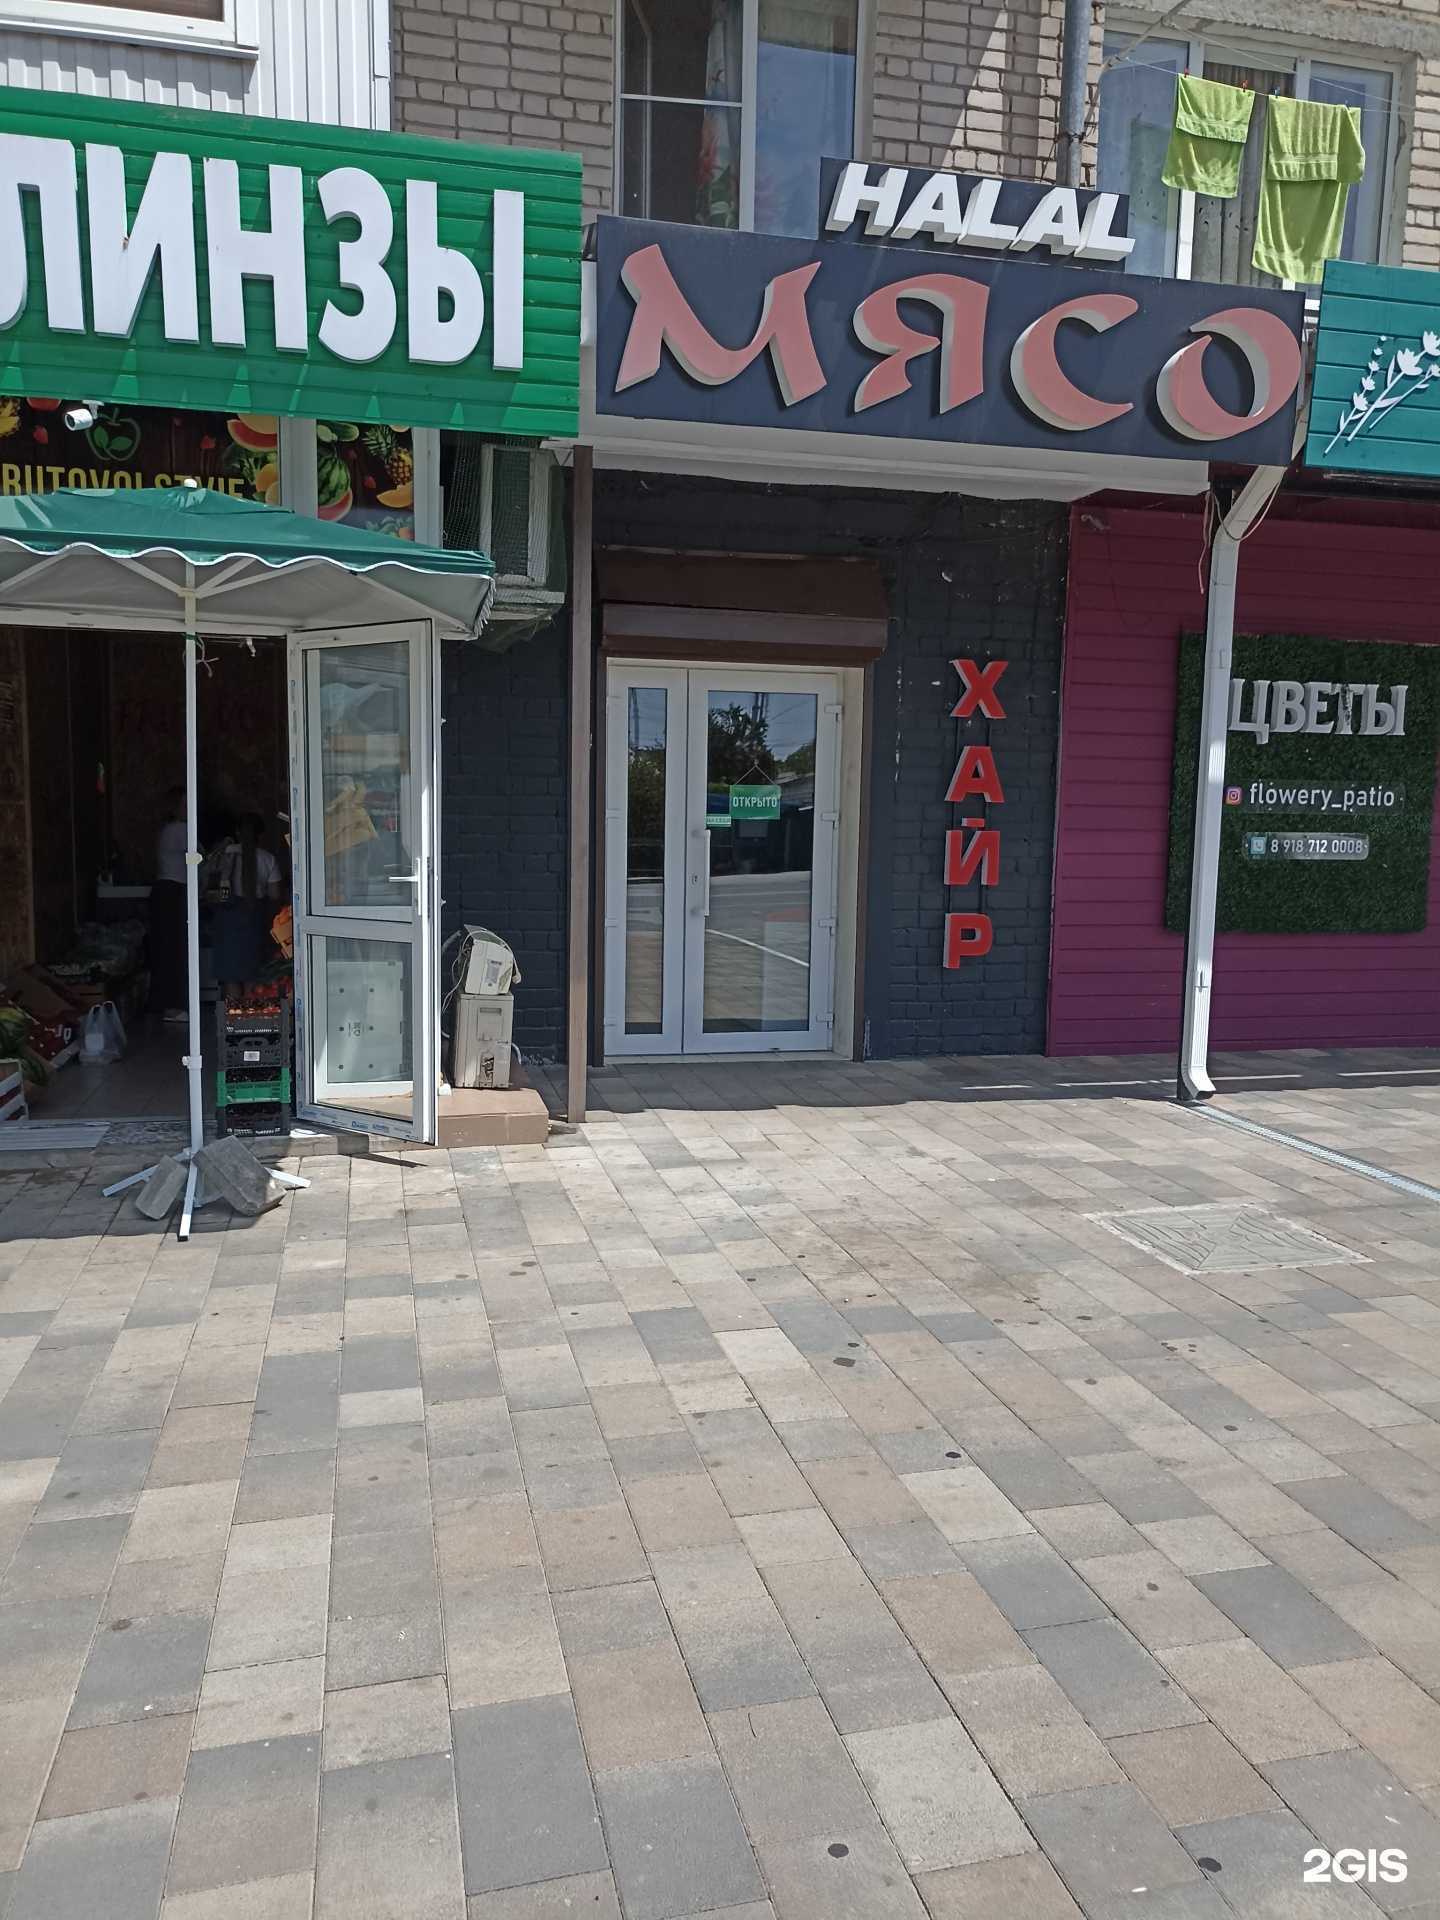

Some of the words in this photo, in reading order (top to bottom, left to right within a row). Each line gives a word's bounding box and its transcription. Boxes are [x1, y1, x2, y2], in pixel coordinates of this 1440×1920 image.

[824, 162, 1135, 261] HALAL
[614, 243, 1302, 441] МЯСО
[1227, 678, 1409, 744] ЦВЕТЫ
[732, 796, 778, 808] ОТКРЫТО
[943, 659, 1009, 969] ХАЙР
[1249, 782, 1395, 811] flowery_patio
[1270, 839, 1279, 853] 8
[1283, 839, 1304, 853] 918
[1308, 839, 1328, 853] 712
[1331, 839, 1363, 853] 0008
